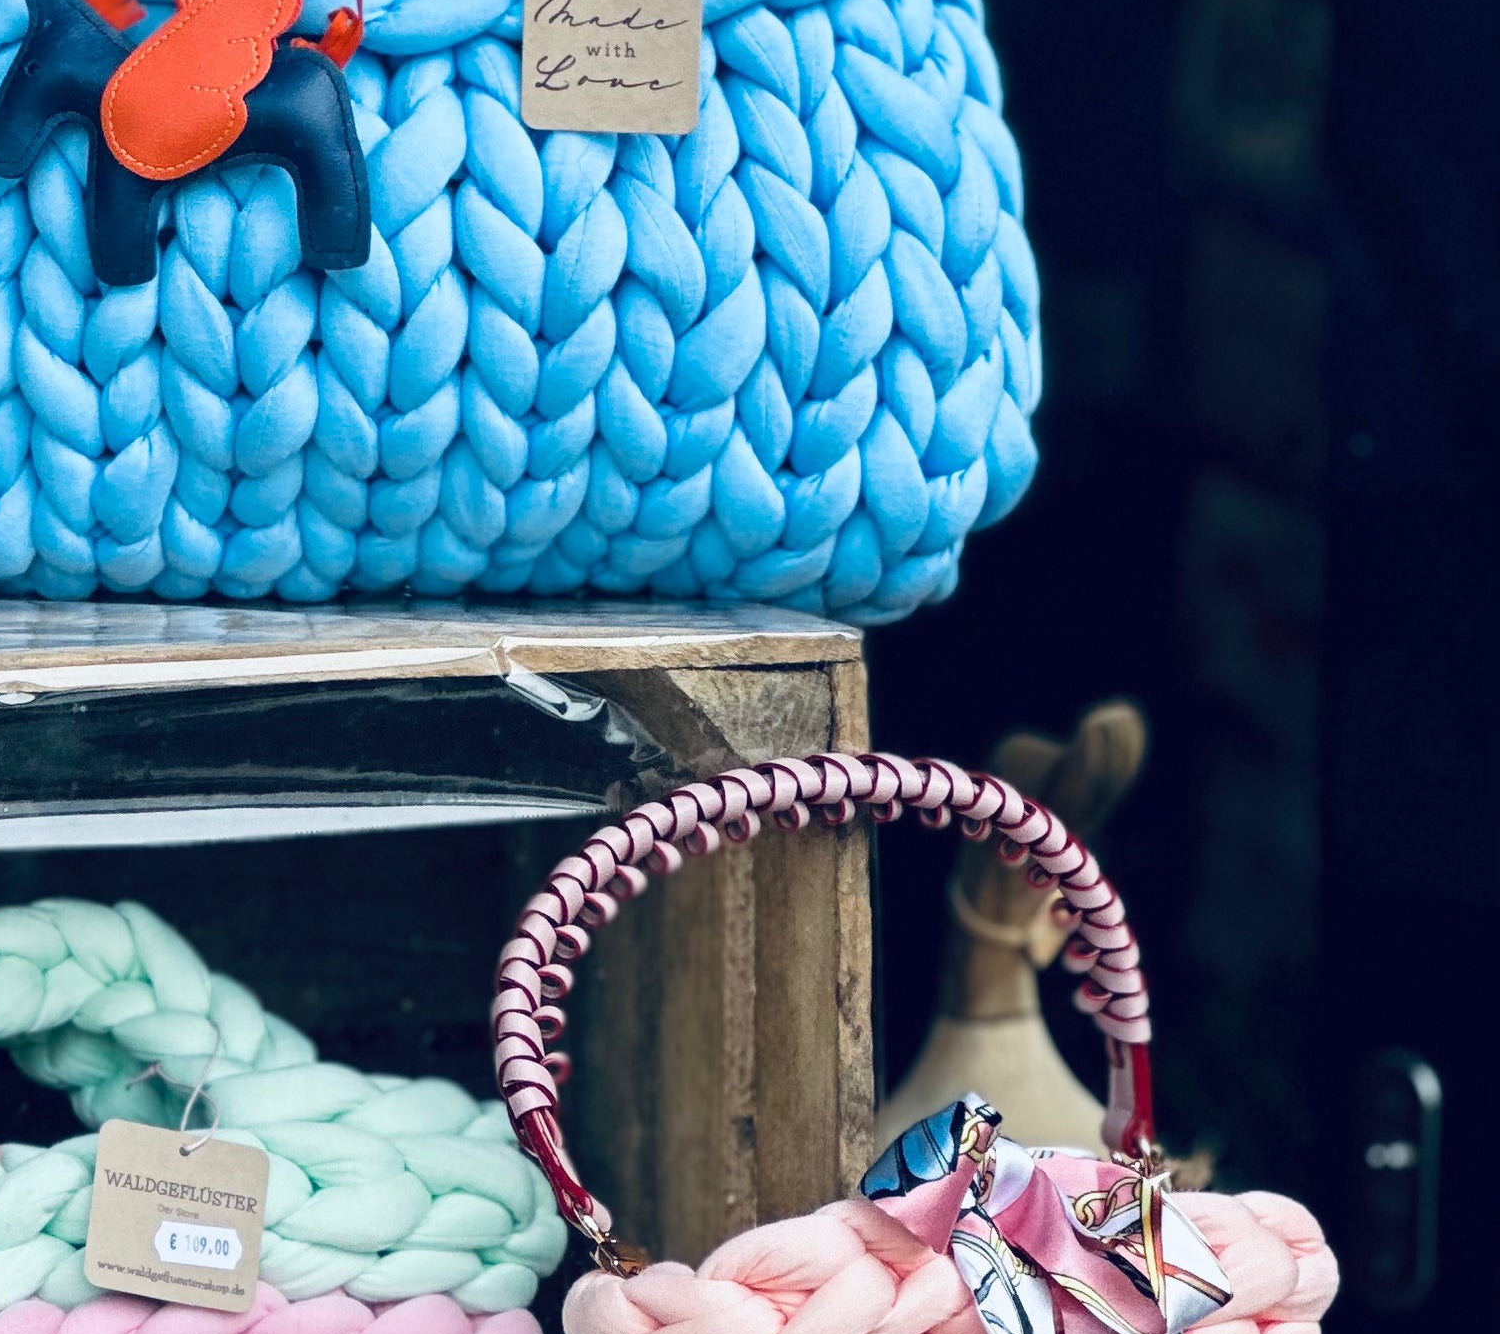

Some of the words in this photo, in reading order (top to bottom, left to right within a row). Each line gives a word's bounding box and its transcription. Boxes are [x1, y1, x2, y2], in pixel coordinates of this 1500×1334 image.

[586, 41, 637, 59] with
[534, 54, 684, 91] Love
[104, 1168, 258, 1214] WALDGEFLÜSTER
[169, 1232, 178, 1250] €
[185, 1234, 230, 1256] 109.00
[97, 1260, 245, 1296] www.waldgefluestershop.de
